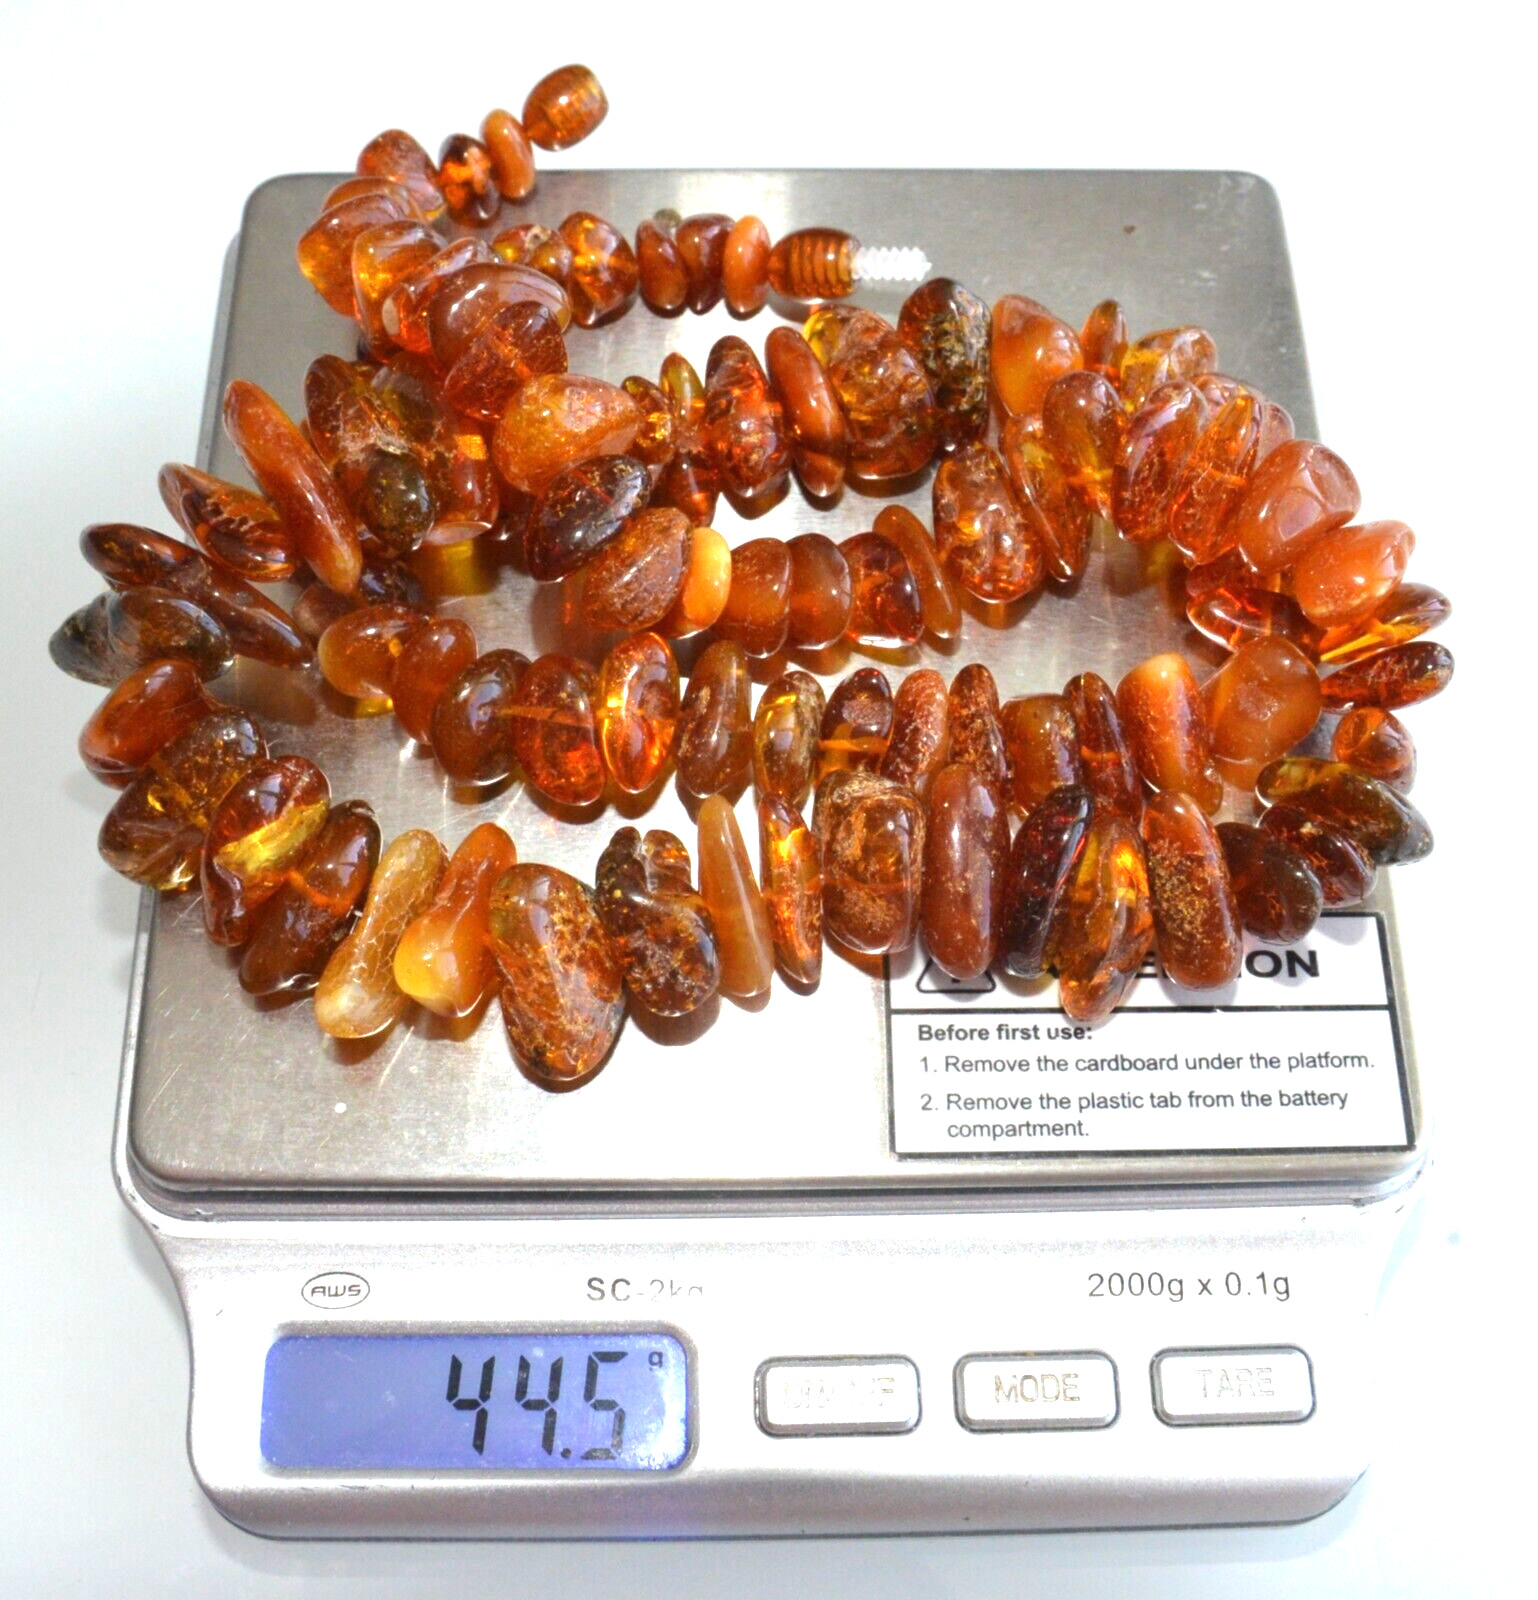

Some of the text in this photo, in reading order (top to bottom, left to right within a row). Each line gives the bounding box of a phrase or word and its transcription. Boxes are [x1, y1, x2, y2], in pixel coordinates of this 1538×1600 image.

[918, 1024, 1093, 1041] Before first use:
[919, 1051, 1376, 1073] 1. Remove the cardboard under the platform.
[920, 1090, 1349, 1113] 2. Remove the plastic tab from the battery
[947, 1120, 1090, 1141] compartment.
[310, 1284, 363, 1298] AWS
[1087, 1271, 1292, 1303] 2000g x 0.1g
[993, 1373, 1082, 1404] MODE
[1193, 1367, 1276, 1399] TARE
[445, 1350, 629, 1461] 44.5
